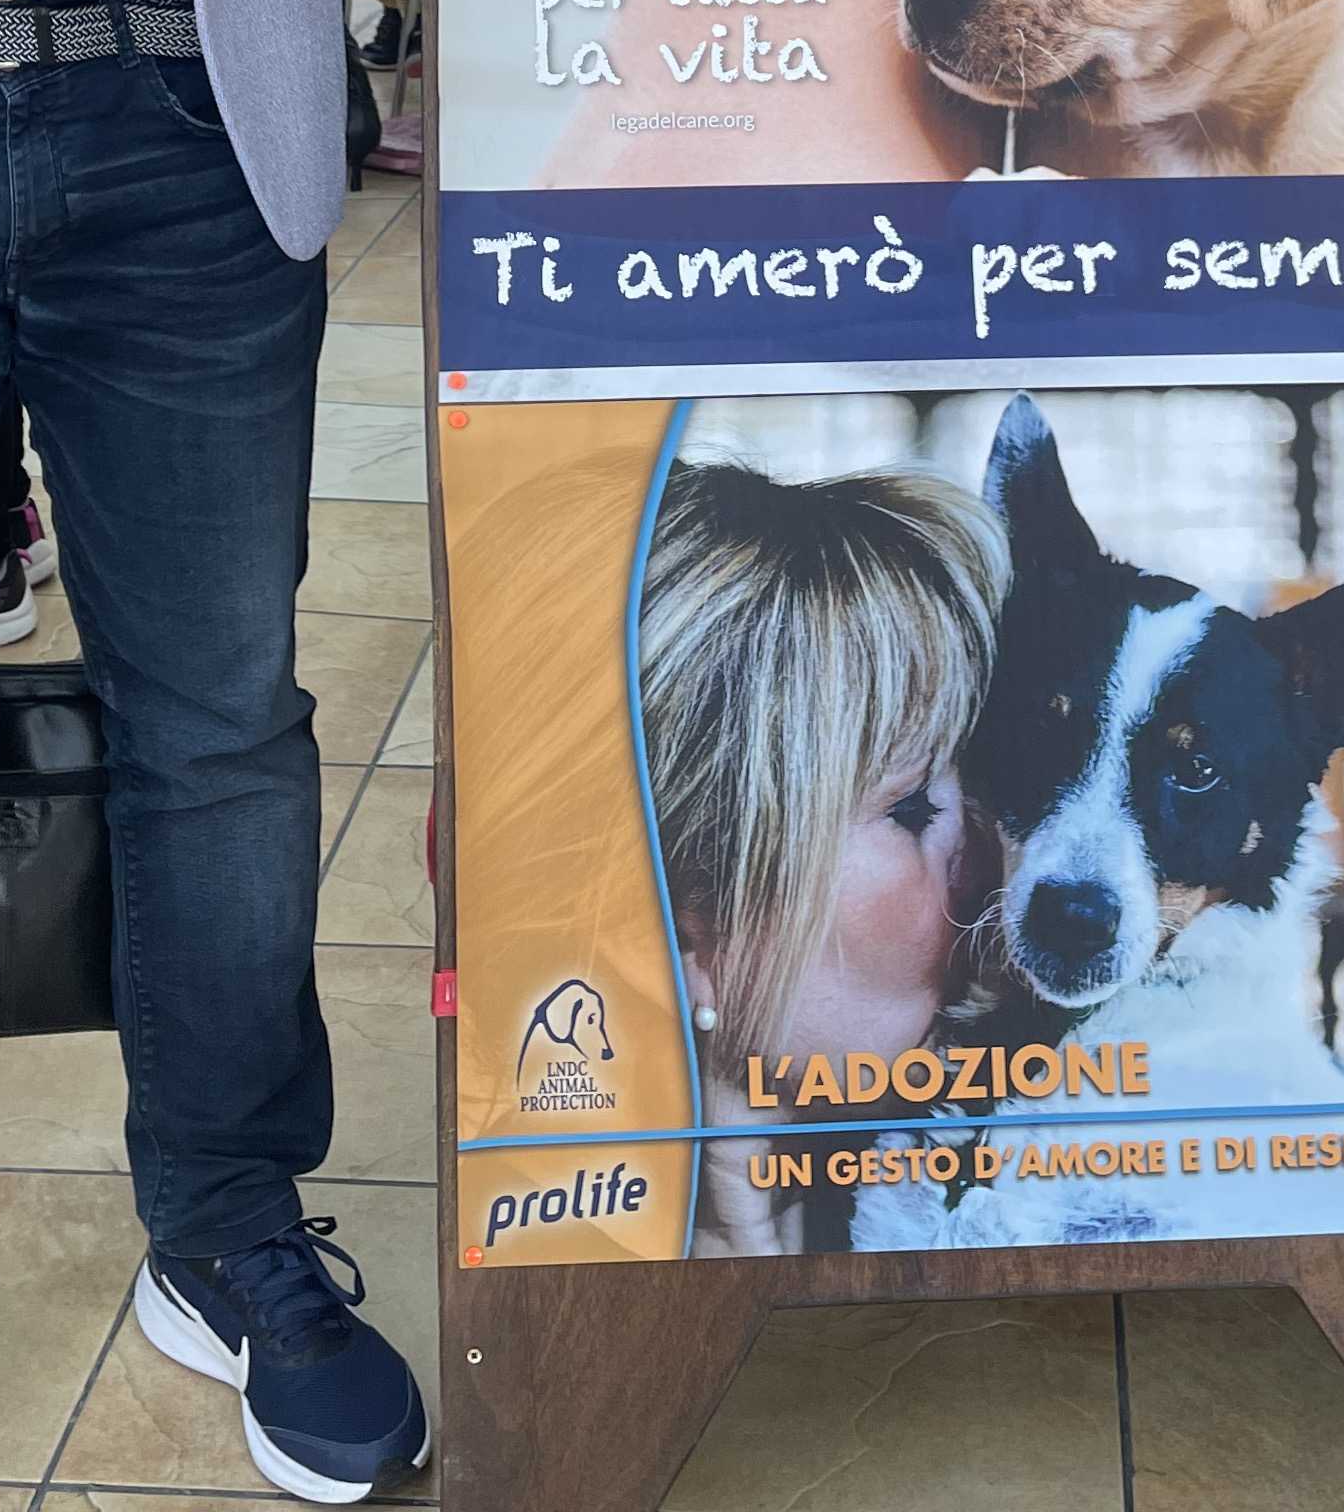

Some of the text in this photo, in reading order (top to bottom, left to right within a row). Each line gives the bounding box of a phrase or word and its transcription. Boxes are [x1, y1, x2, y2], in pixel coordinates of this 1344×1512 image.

[659, 14, 828, 83] vita
[611, 111, 755, 133] legadelcane.org
[472, 231, 573, 306] Ti
[617, 214, 924, 301] amerò
[971, 240, 1117, 339] per
[538, 1076, 598, 1095] ANIMAL
[547, 1060, 589, 1078] LNDC
[747, 1041, 1151, 1108] L'ADOZIONE
[520, 1092, 616, 1112] PROTECTION
[749, 1153, 813, 1189] UN
[827, 1146, 960, 1186] GESTO
[974, 1140, 1167, 1180] D'AMORE
[1181, 1138, 1201, 1172] E
[1216, 1135, 1256, 1170] DI
[485, 1162, 648, 1248] prolife
